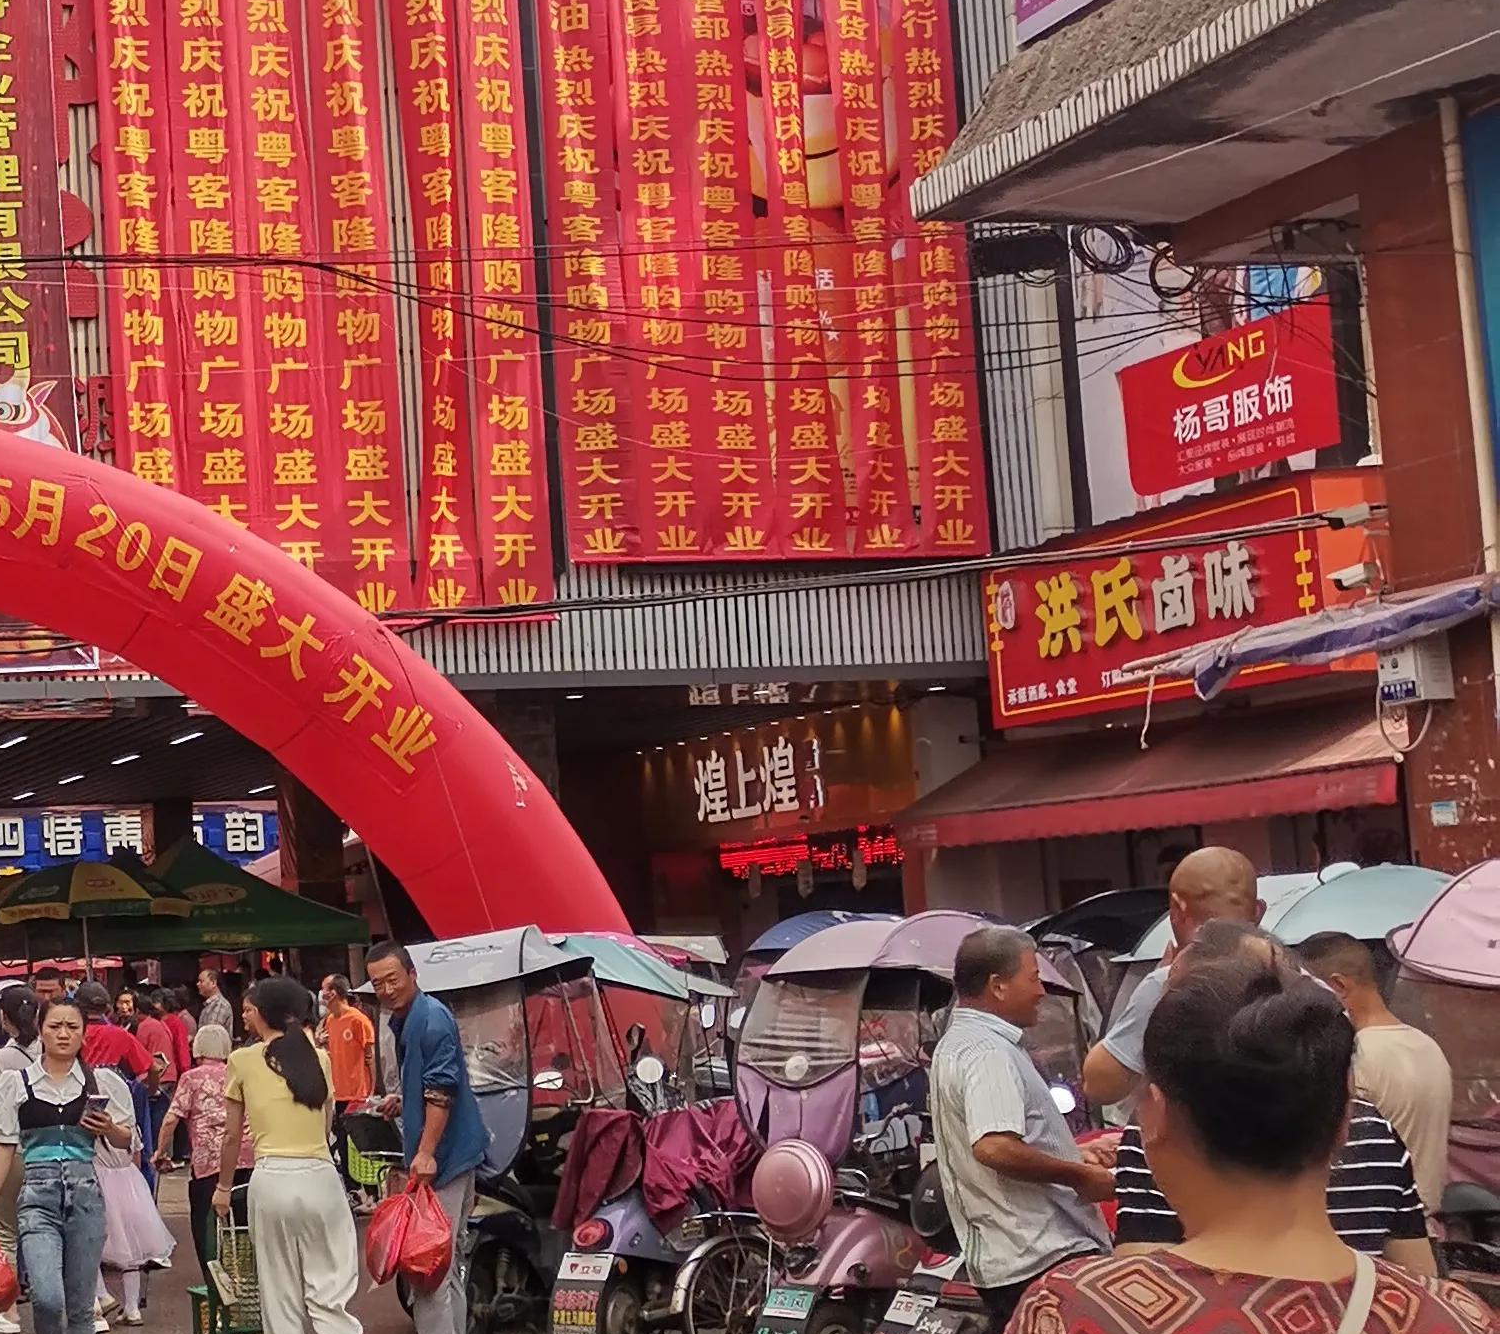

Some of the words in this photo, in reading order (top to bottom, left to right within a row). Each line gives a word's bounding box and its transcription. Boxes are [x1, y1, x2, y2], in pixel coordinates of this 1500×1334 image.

[1172, 374, 1294, 445] 杨哥服饰
[1034, 540, 1256, 660] 洪氏卤味
[694, 734, 800, 824] 煌上煌
